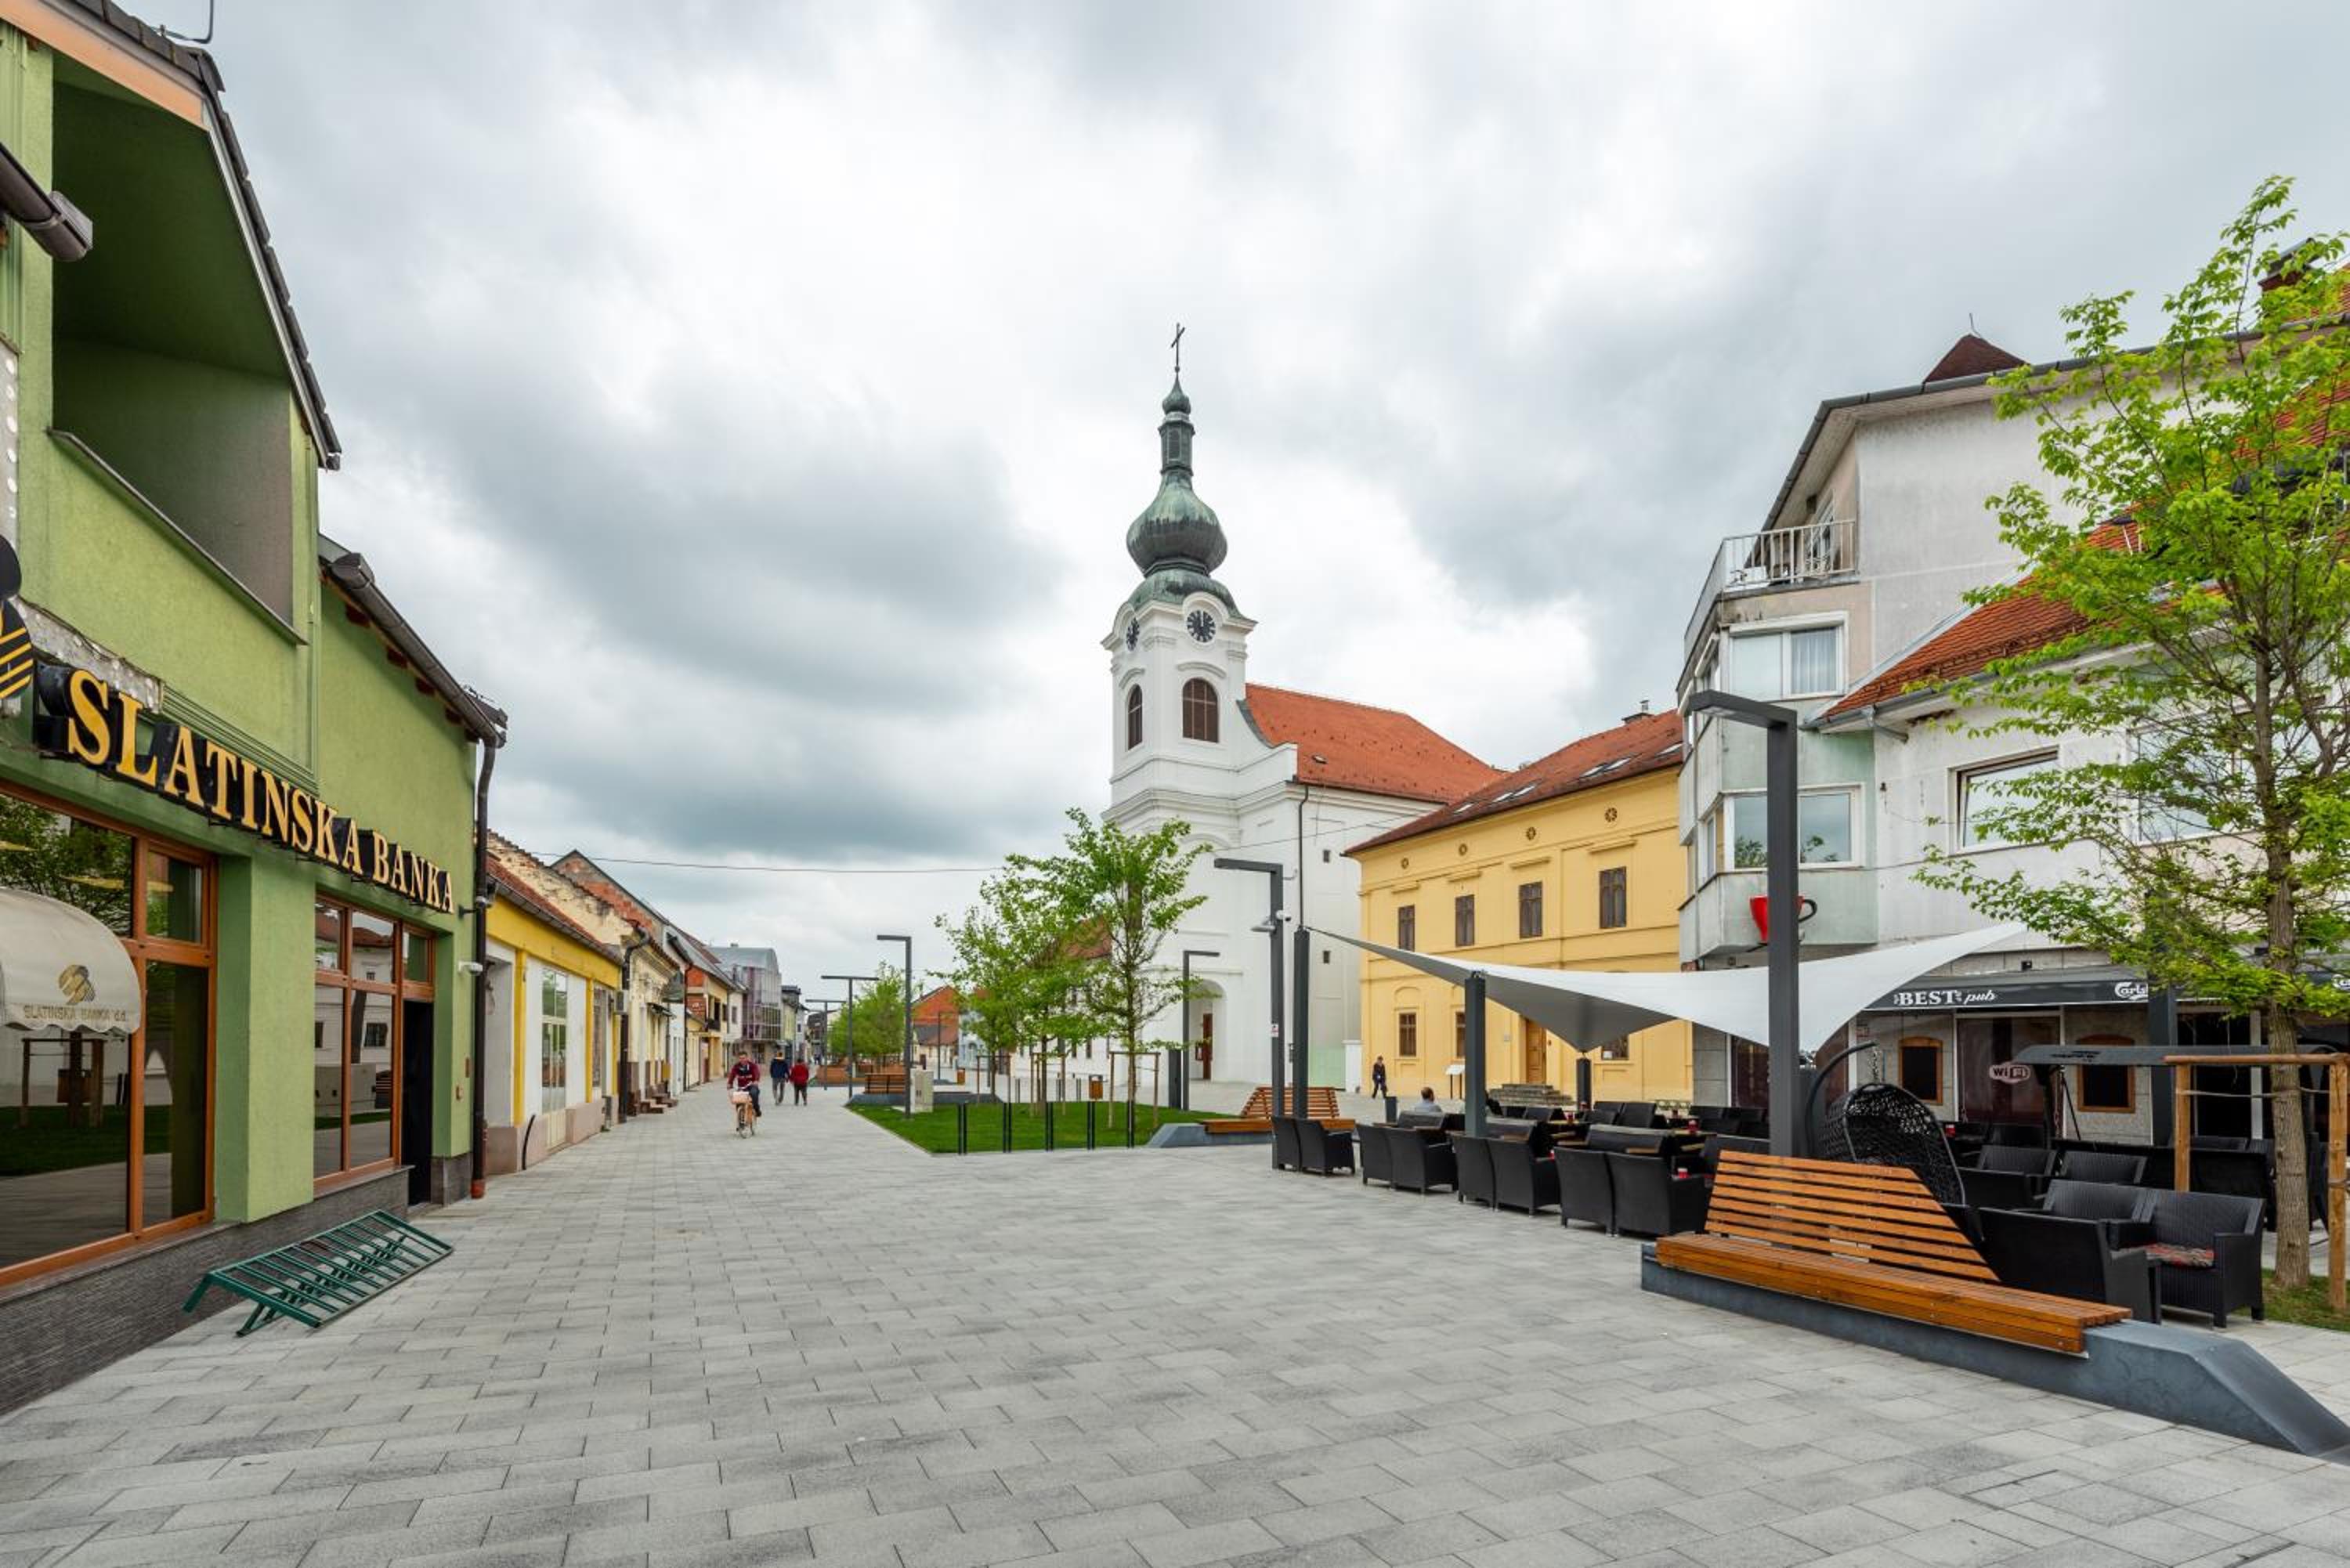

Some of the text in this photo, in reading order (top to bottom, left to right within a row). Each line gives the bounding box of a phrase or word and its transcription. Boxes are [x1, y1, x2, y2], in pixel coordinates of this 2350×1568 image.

[69, 670, 454, 914] SLATINSKA BANKA
[1898, 990, 1995, 1006] BEST pub
